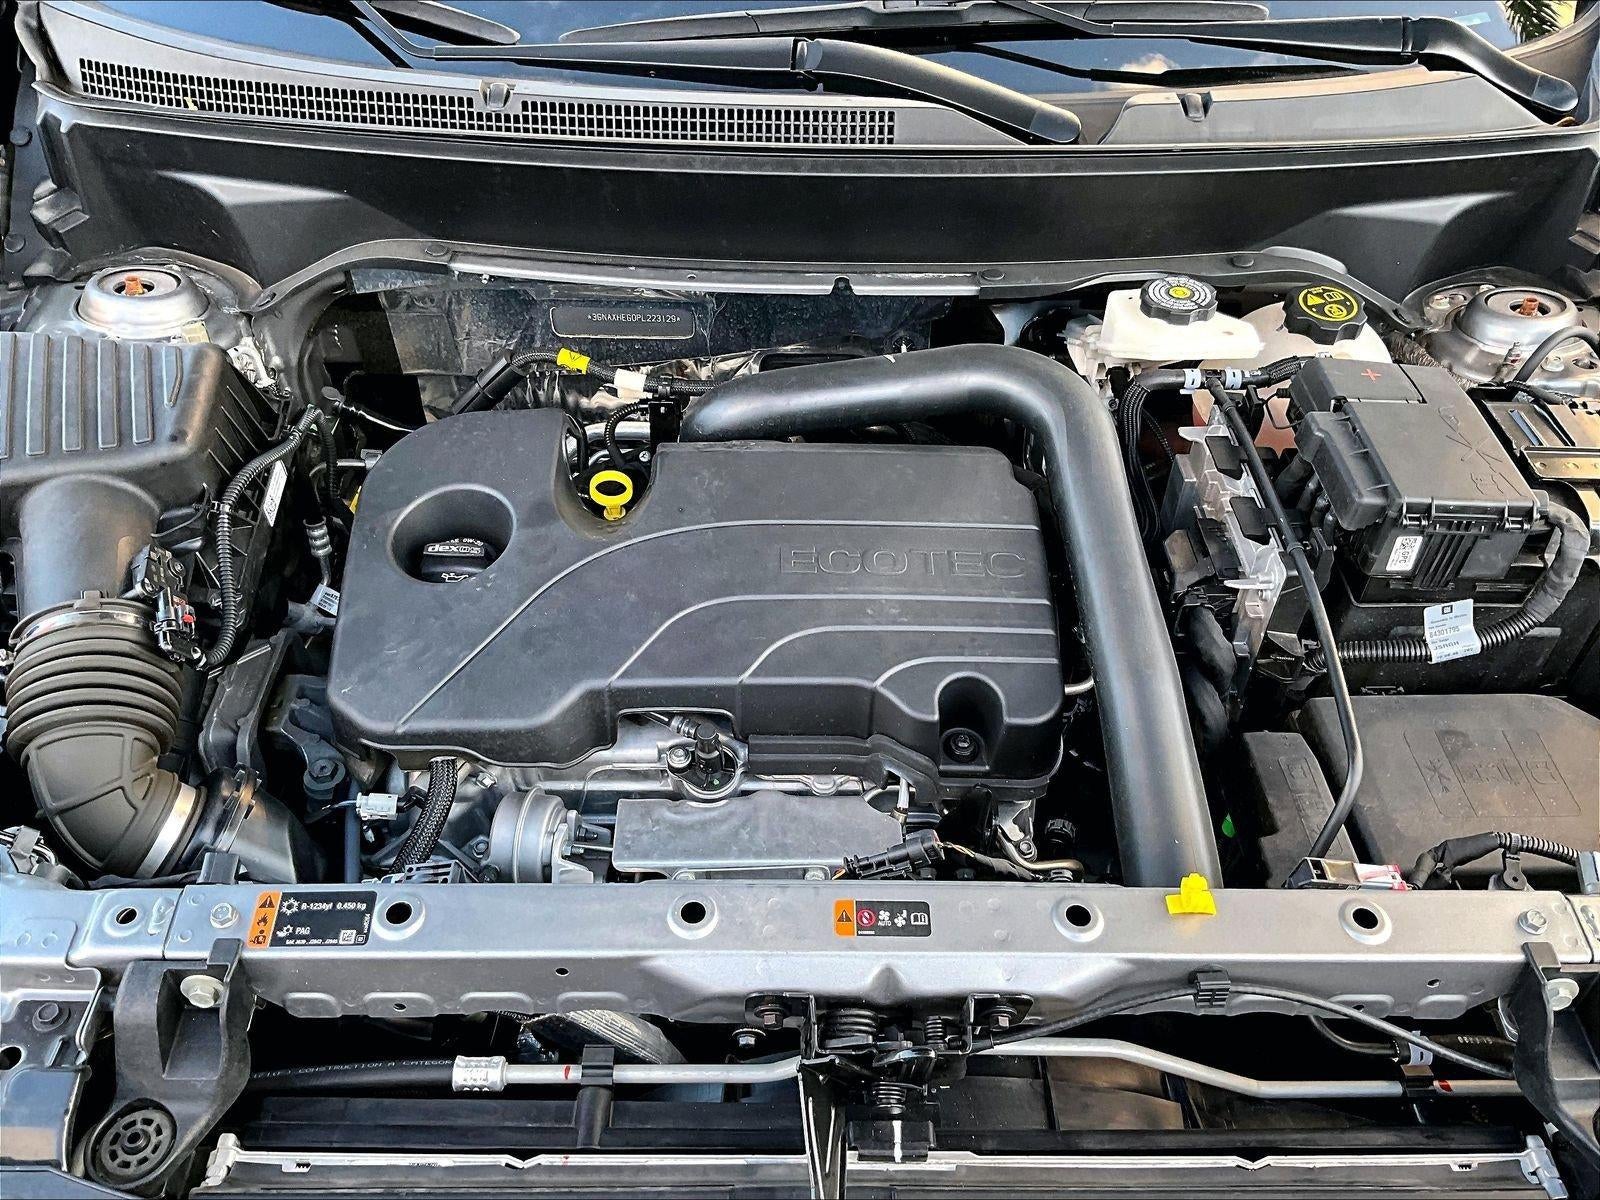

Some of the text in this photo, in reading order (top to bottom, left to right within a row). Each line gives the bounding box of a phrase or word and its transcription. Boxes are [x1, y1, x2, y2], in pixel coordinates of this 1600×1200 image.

[427, 544, 481, 554] dexos
[780, 549, 1026, 578] ECOTEC
[295, 927, 311, 935] PAG
[299, 1062, 383, 1074] CONSTRUCTION
